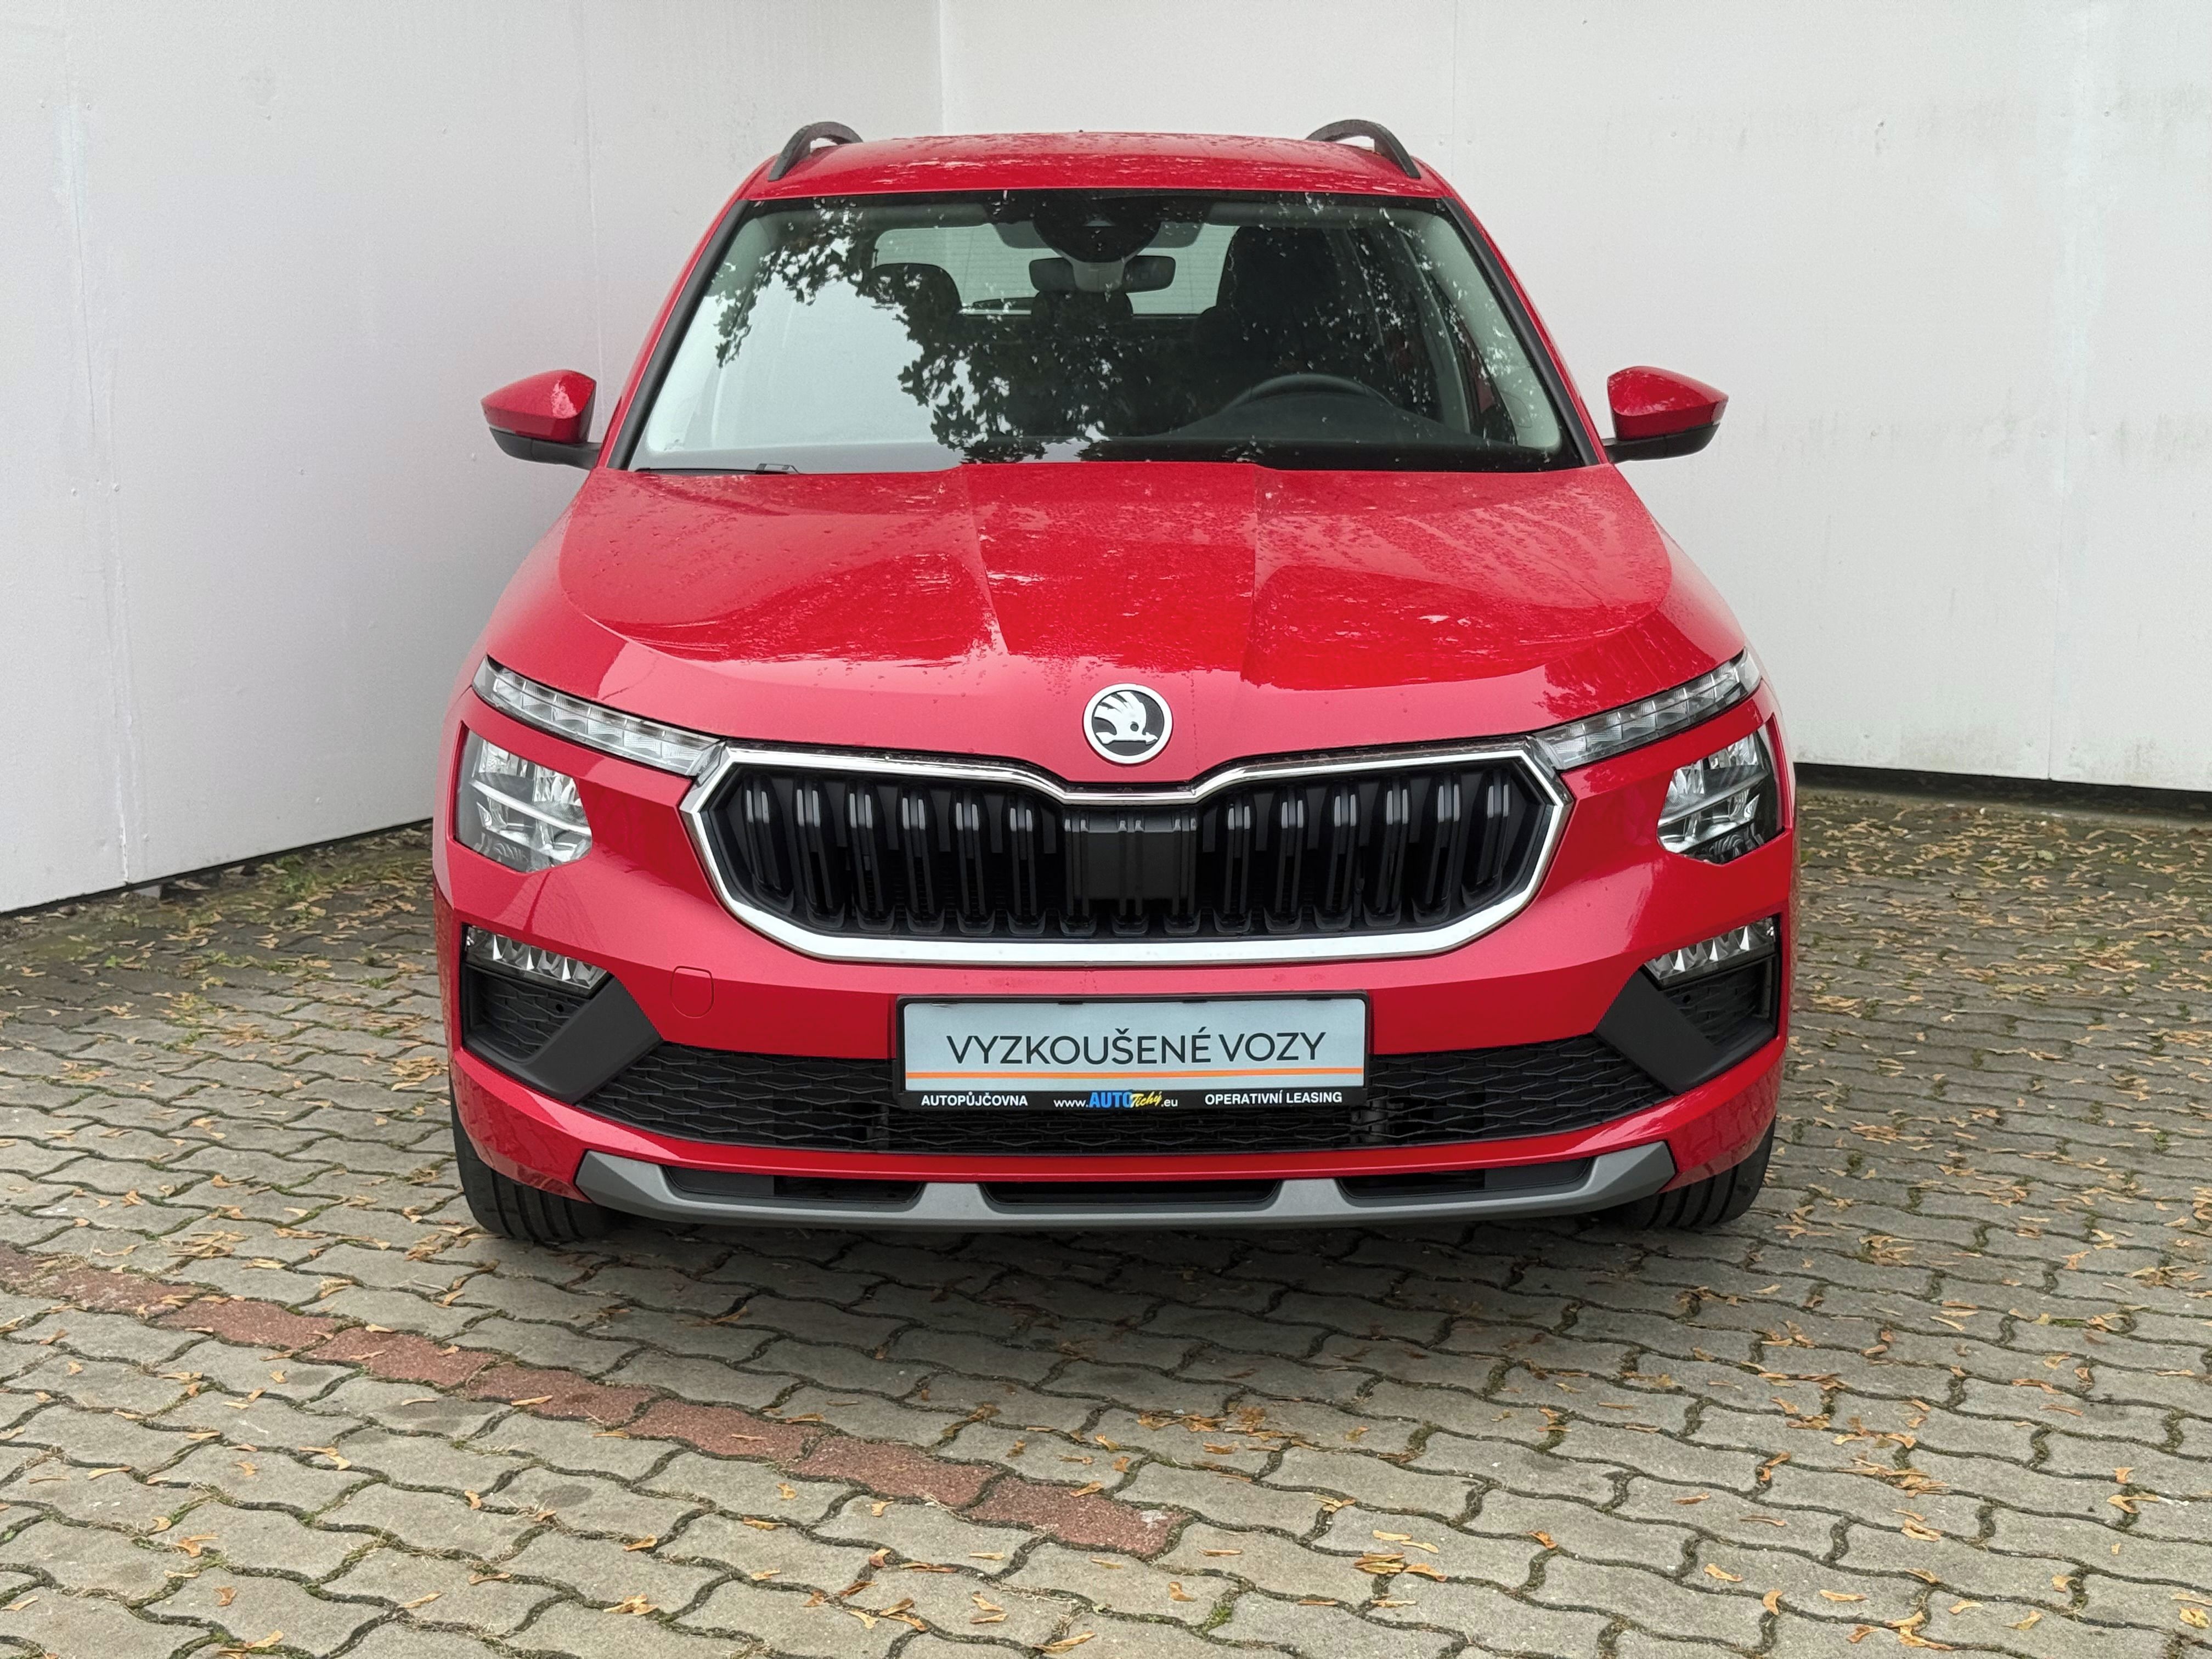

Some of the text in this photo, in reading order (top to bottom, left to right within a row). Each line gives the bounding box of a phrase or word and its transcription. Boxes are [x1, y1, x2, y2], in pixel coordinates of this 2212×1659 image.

[946, 1026, 1327, 1064] VYZKOUŠENÉ VOZY
[921, 1091, 1028, 1106] AUTOPŮJČOVNA
[1205, 1090, 1342, 1105] OPERATIVNÍ LEASING
